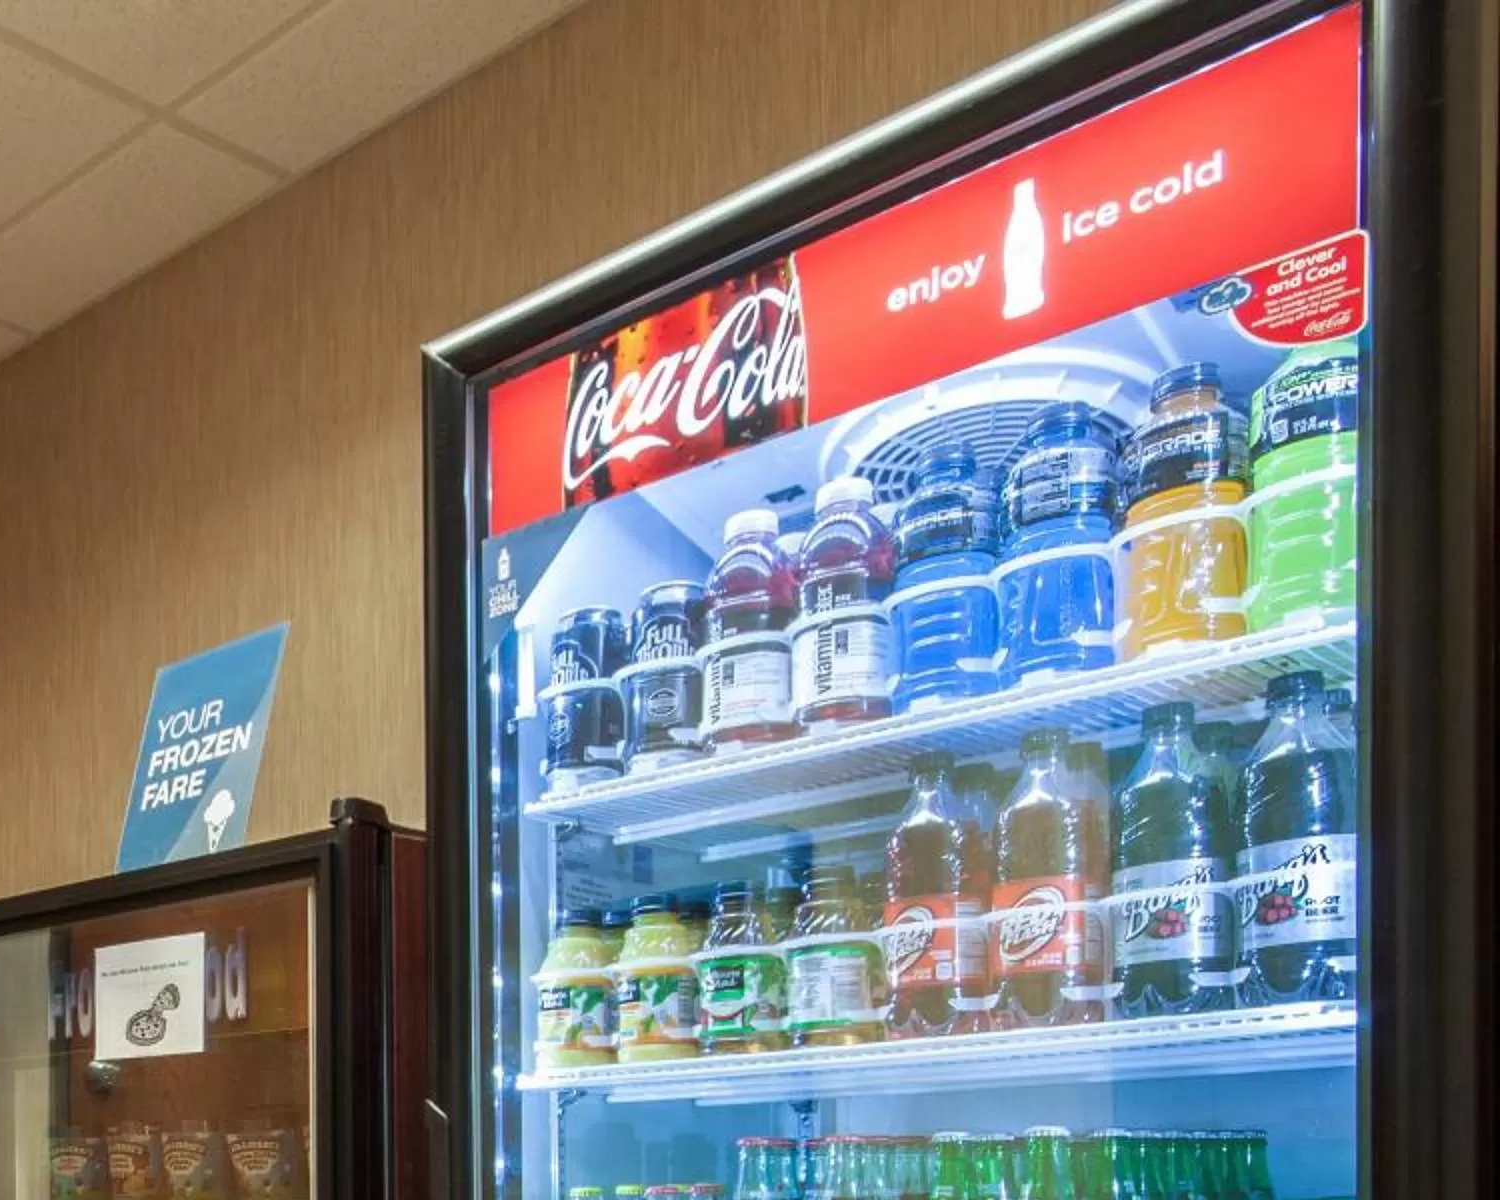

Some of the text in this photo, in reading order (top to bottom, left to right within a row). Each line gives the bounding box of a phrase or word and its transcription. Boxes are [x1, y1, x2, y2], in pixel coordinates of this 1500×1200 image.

[886, 150, 1226, 312] enjoy ice cold
[1266, 256, 1347, 297] and Cool
[1277, 247, 1337, 277] Clever
[563, 276, 807, 490] Coca-Cola
[1272, 374, 1359, 408] POWER
[157, 699, 224, 744] YOUR
[148, 722, 254, 778] FROZEN
[140, 768, 207, 812] FARE
